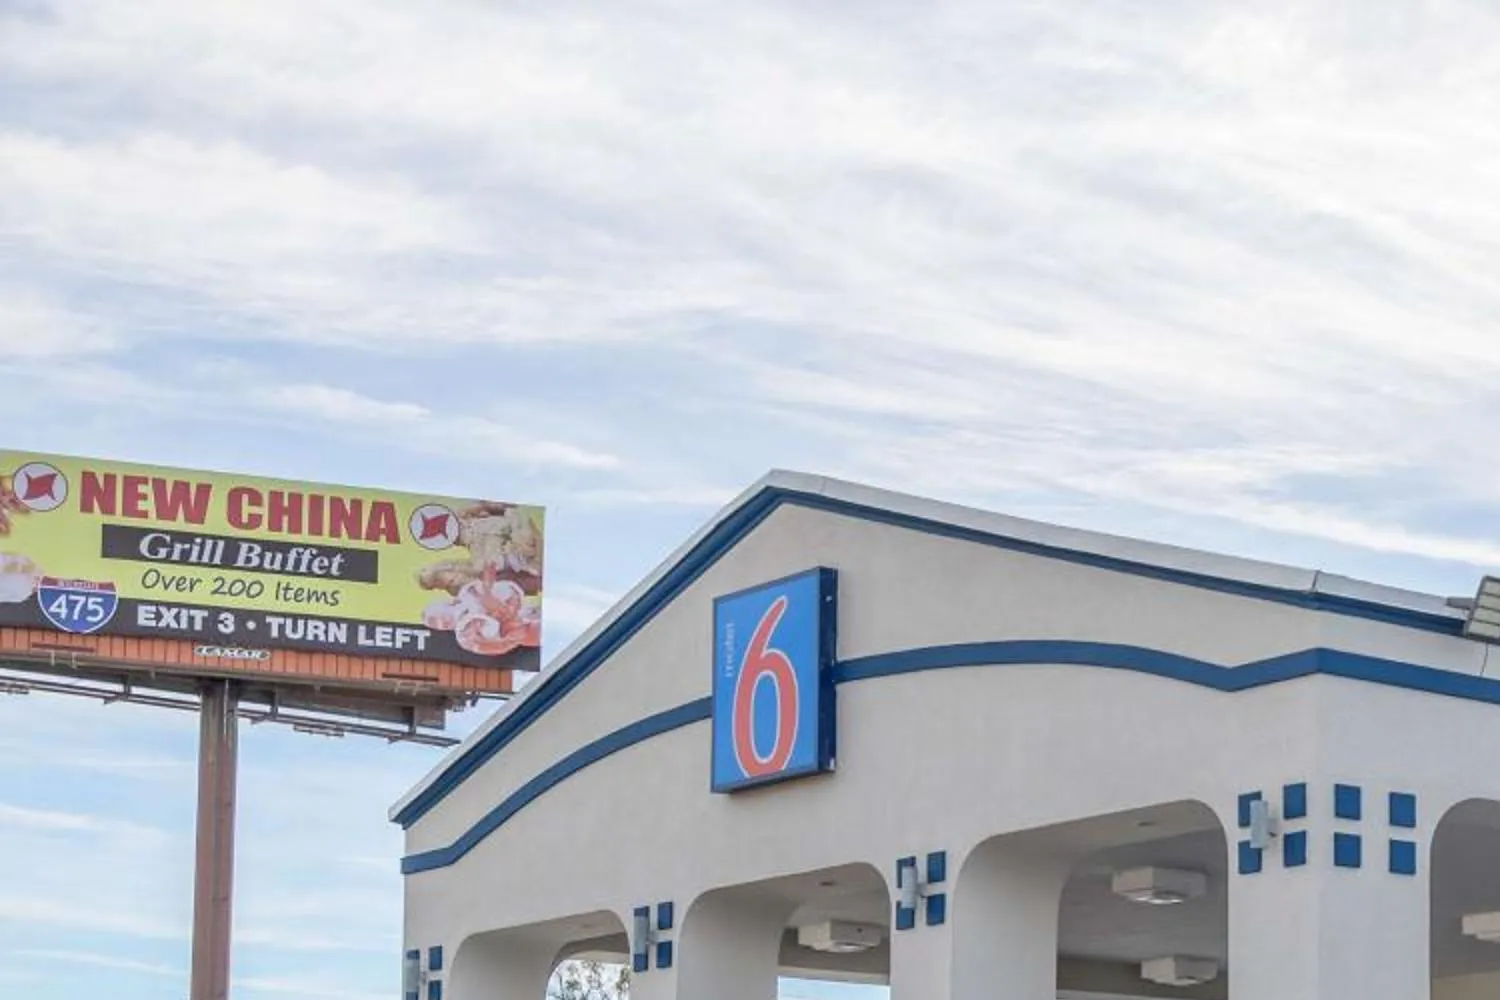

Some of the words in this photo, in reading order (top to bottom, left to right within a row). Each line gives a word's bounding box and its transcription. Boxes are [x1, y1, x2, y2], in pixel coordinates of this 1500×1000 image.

[80, 471, 213, 525] NEW
[226, 486, 401, 544] CHINA
[139, 533, 225, 565] Grill
[234, 541, 344, 576] Buffet
[48, 593, 104, 622] 475
[142, 568, 202, 593] Over
[211, 576, 264, 599] 200
[275, 581, 341, 606] Items
[137, 605, 208, 630] EXIT
[217, 612, 235, 634] 3
[265, 616, 347, 643] TURN
[357, 624, 431, 650] LEFT
[732, 595, 798, 778] 6
